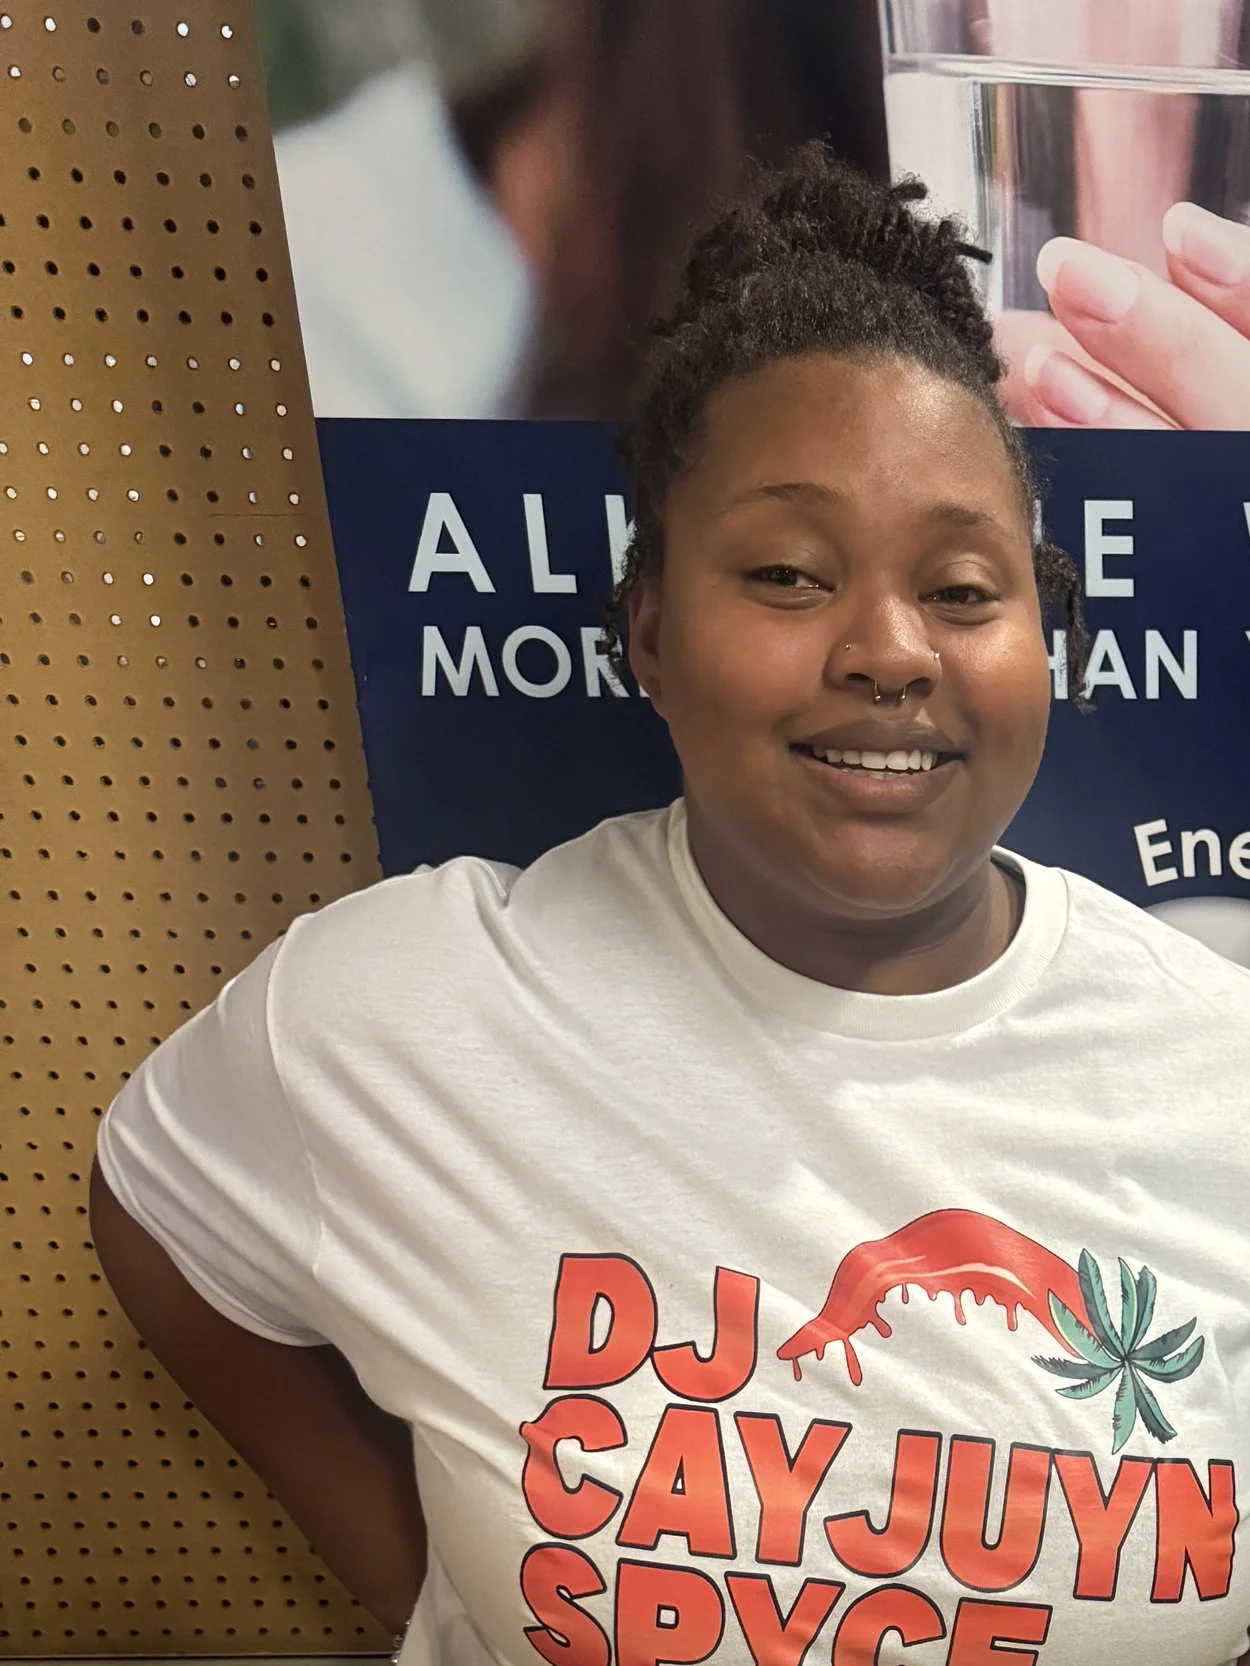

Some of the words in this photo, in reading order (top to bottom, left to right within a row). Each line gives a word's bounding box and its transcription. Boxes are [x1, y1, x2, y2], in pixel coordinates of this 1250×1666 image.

[421, 626, 650, 699] MOR
[1048, 629, 1198, 700] HAN
[543, 1252, 761, 1403] DJ
[519, 1393, 1240, 1604] CAYJUYN
